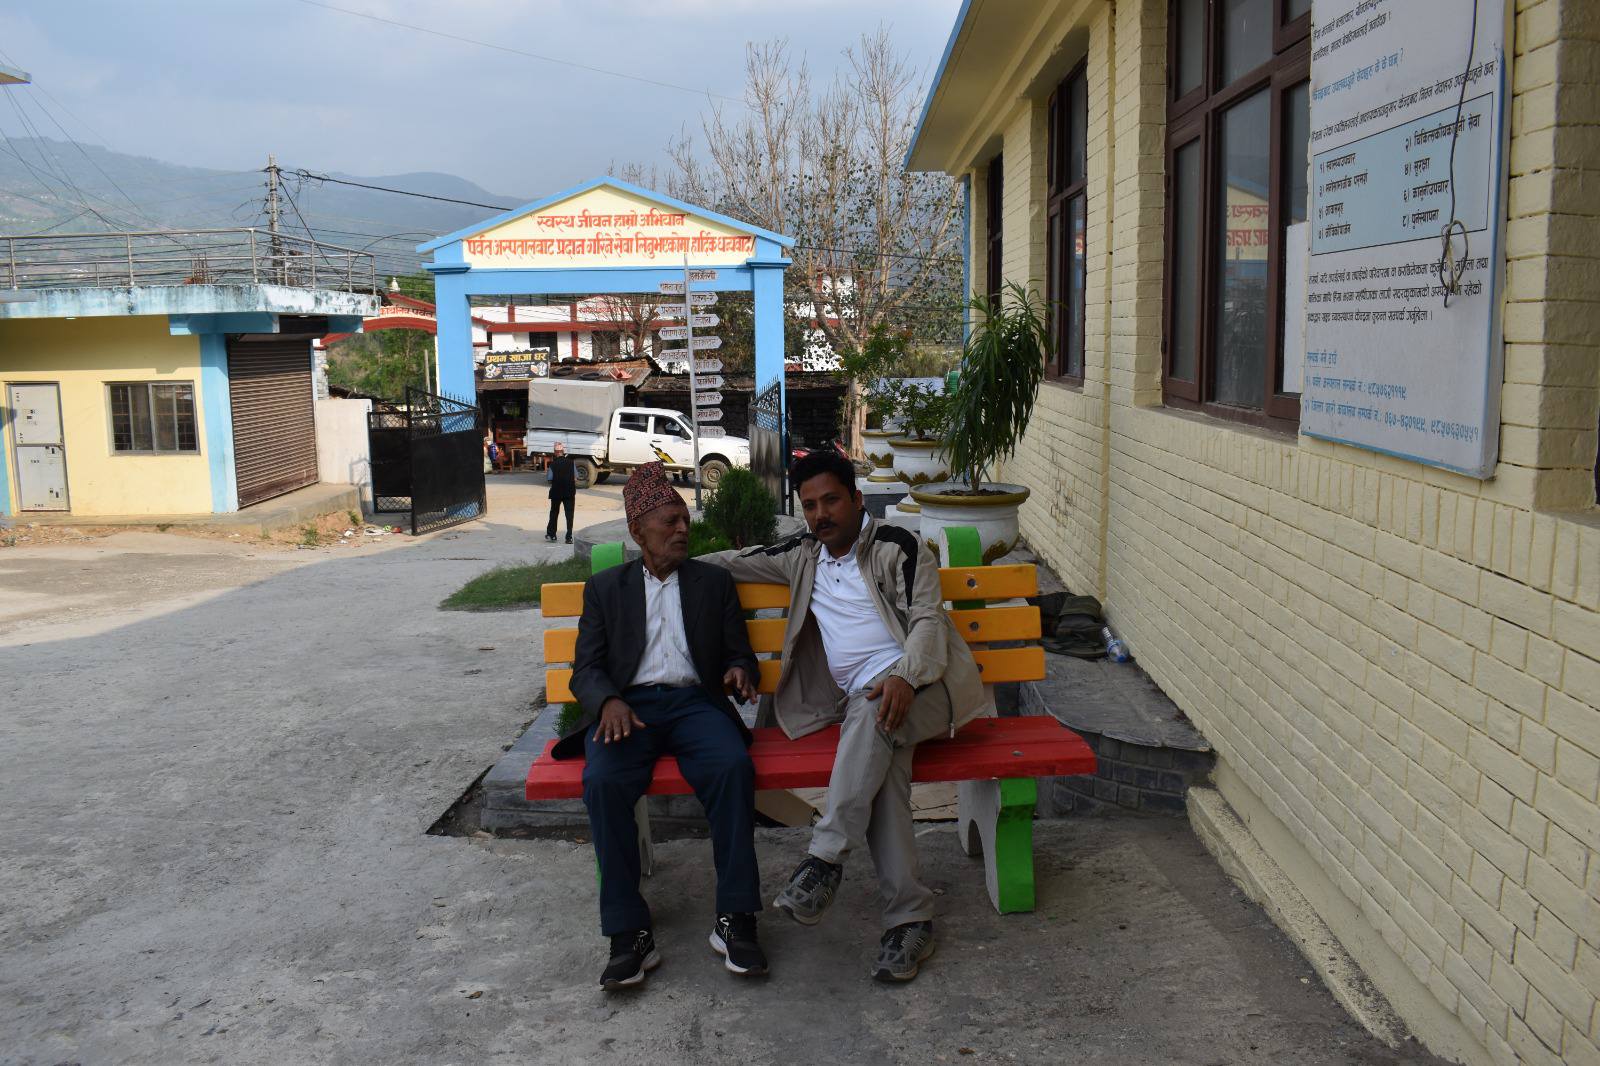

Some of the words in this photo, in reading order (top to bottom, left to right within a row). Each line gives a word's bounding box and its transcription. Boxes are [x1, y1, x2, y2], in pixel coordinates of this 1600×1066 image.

[1468, 113, 1481, 133] सेवा
[578, 208, 611, 228] जीवन
[614, 210, 639, 231] हाम्रो
[467, 234, 492, 257] पर्वत
[493, 238, 555, 258] अस्पतालबाट
[556, 238, 585, 257] प्रदान
[586, 232, 613, 257] गरिने
[614, 232, 633, 256] सेवा
[692, 231, 716, 256] हार्दिक
[1464, 280, 1482, 296] रहेको
[509, 353, 532, 362] खाजा
[534, 353, 548, 361] घर
